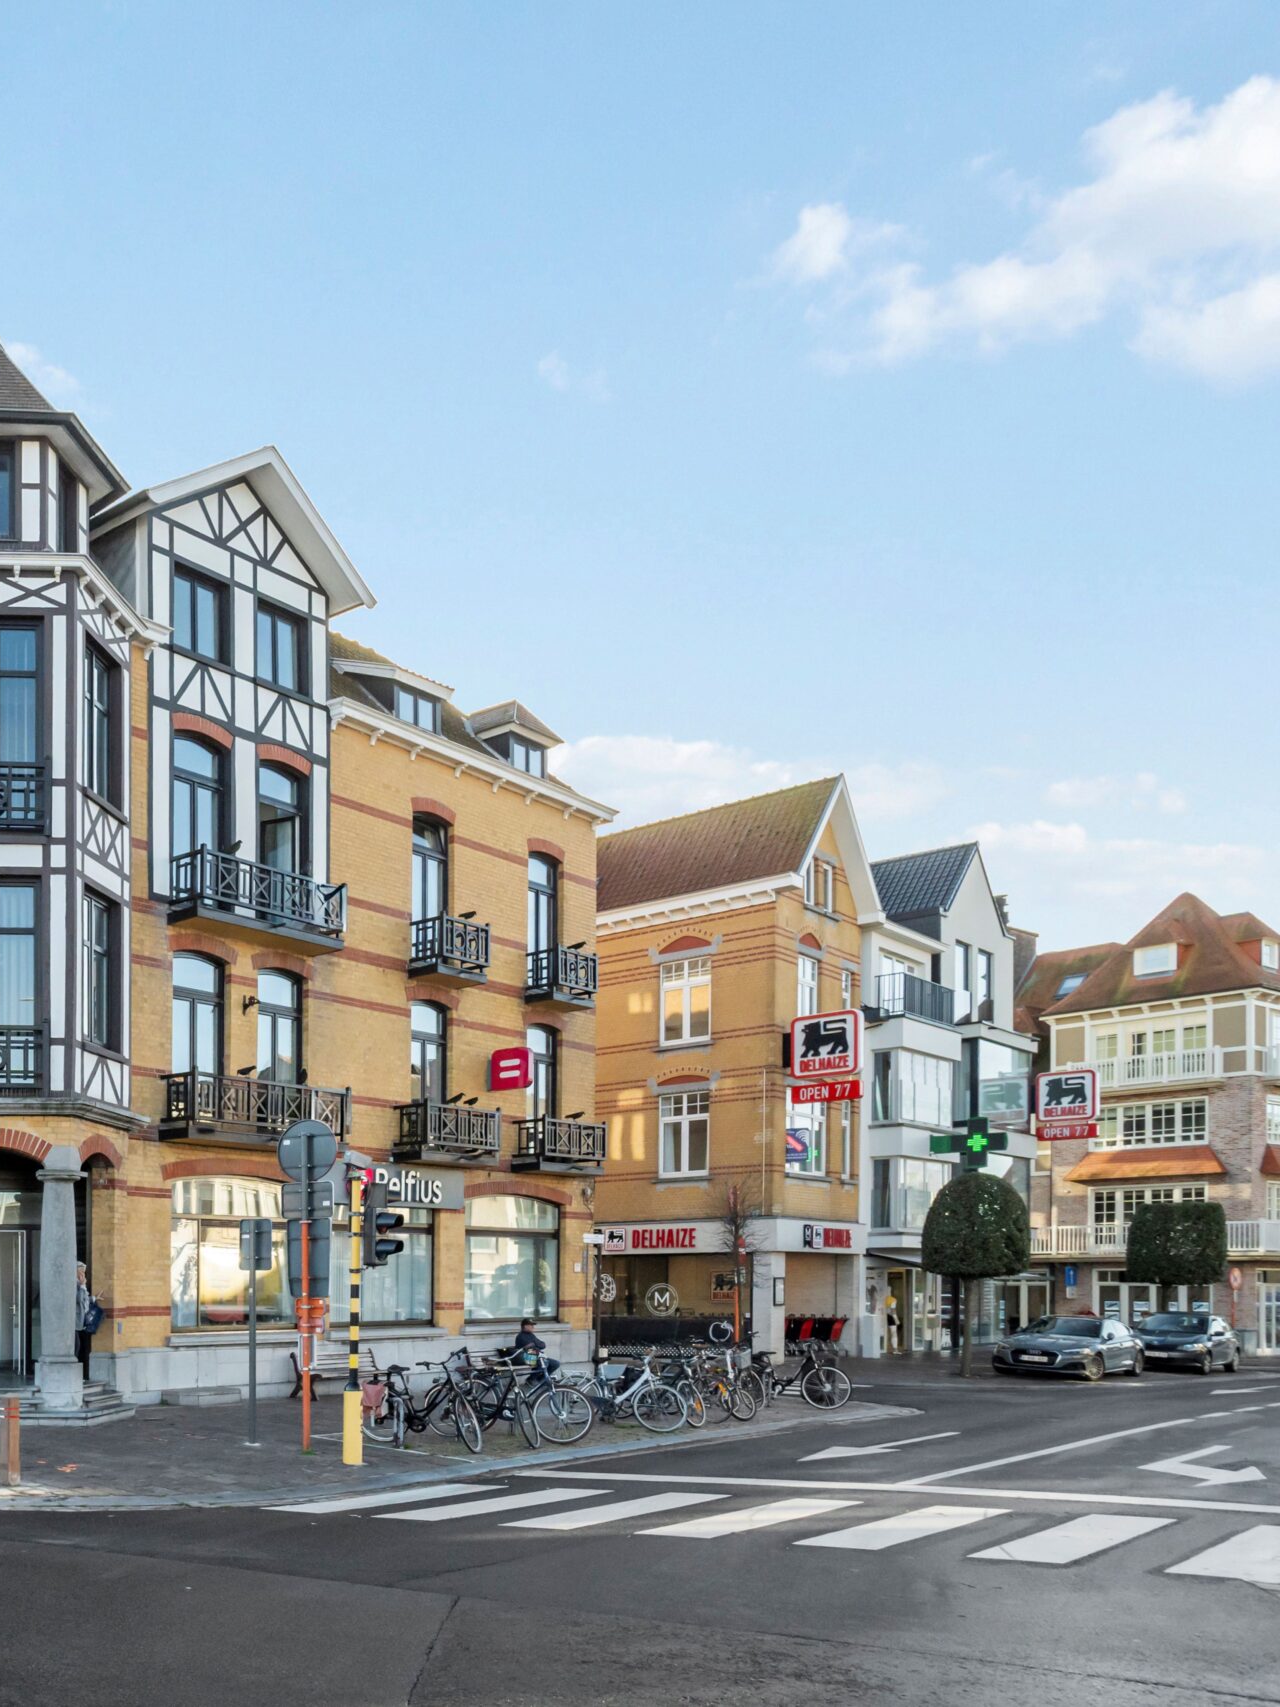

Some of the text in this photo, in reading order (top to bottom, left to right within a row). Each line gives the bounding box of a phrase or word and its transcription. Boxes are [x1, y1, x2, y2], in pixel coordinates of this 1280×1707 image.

[799, 1054, 850, 1073] DELHAIZE
[799, 1085, 829, 1101] OPEN
[1043, 1104, 1088, 1118] DELHAIZE
[1043, 1127, 1070, 1139] OPEN
[631, 1227, 697, 1249] DELHAIZE
